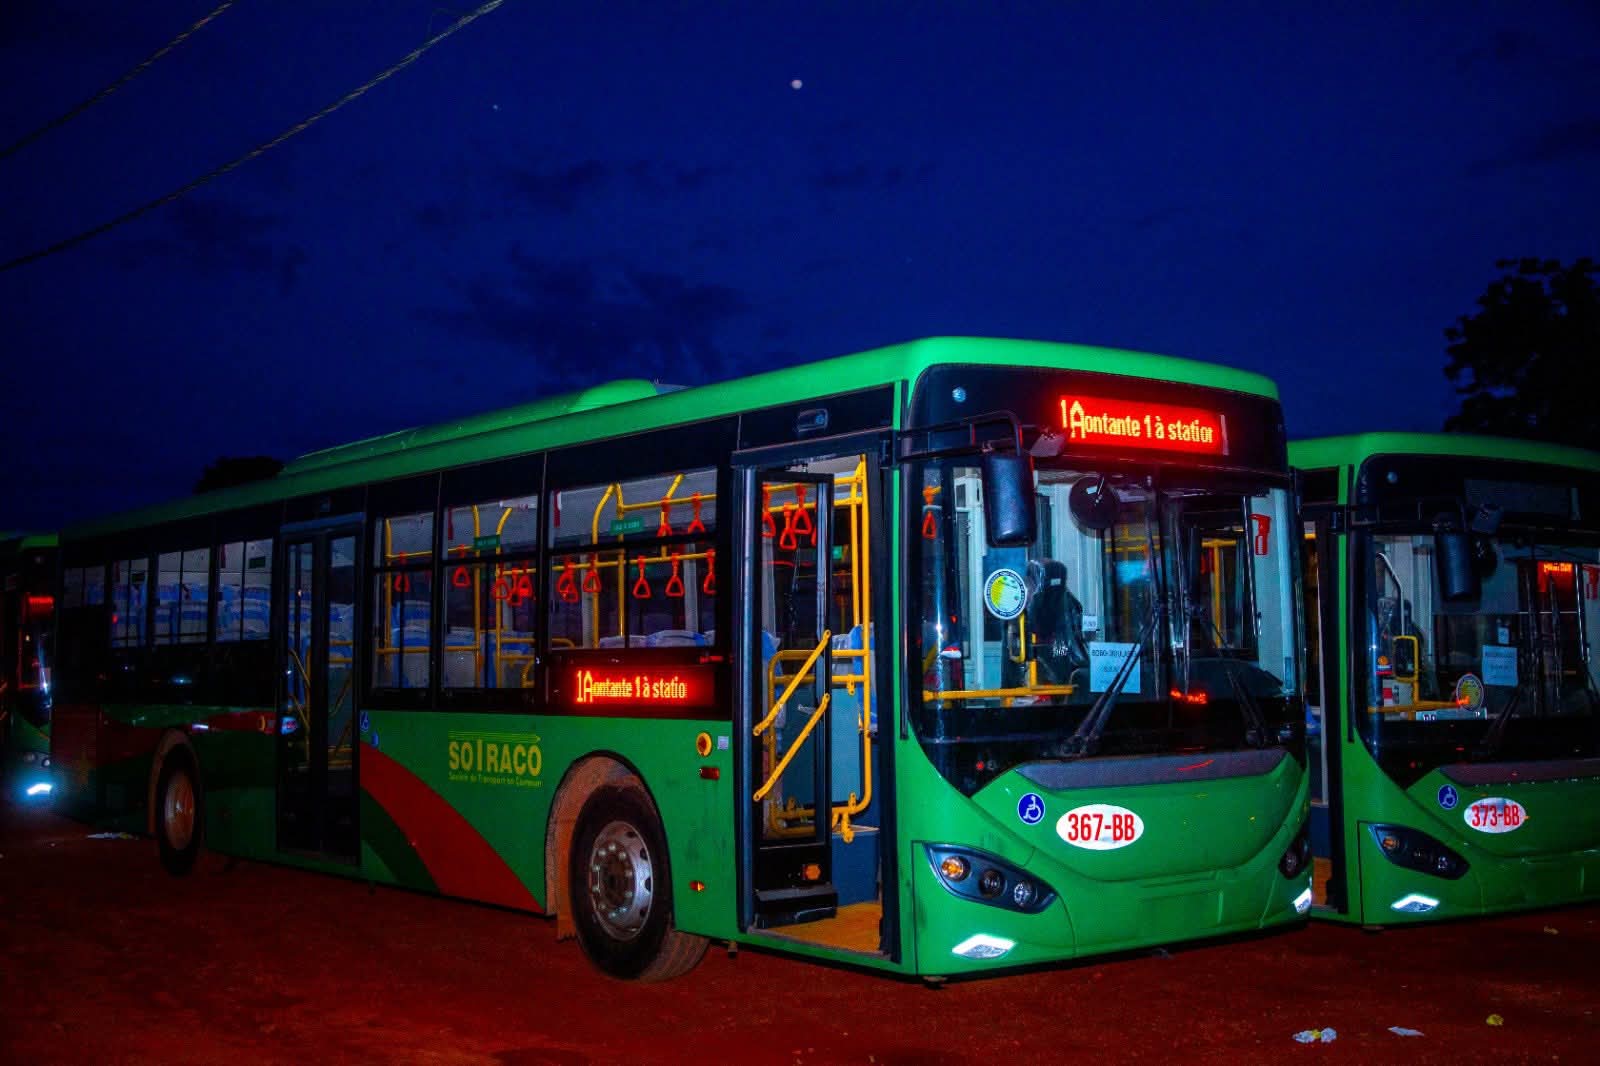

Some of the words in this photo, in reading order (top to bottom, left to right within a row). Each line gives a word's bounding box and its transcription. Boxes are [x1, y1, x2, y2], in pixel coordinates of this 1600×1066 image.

[1144, 414, 1152, 438] 1
[1154, 415, 1165, 439] à
[635, 676, 641, 698] 1
[643, 676, 651, 698] à
[1068, 813, 1135, 841] 367-BB
[1471, 804, 1520, 827] 373-BB
